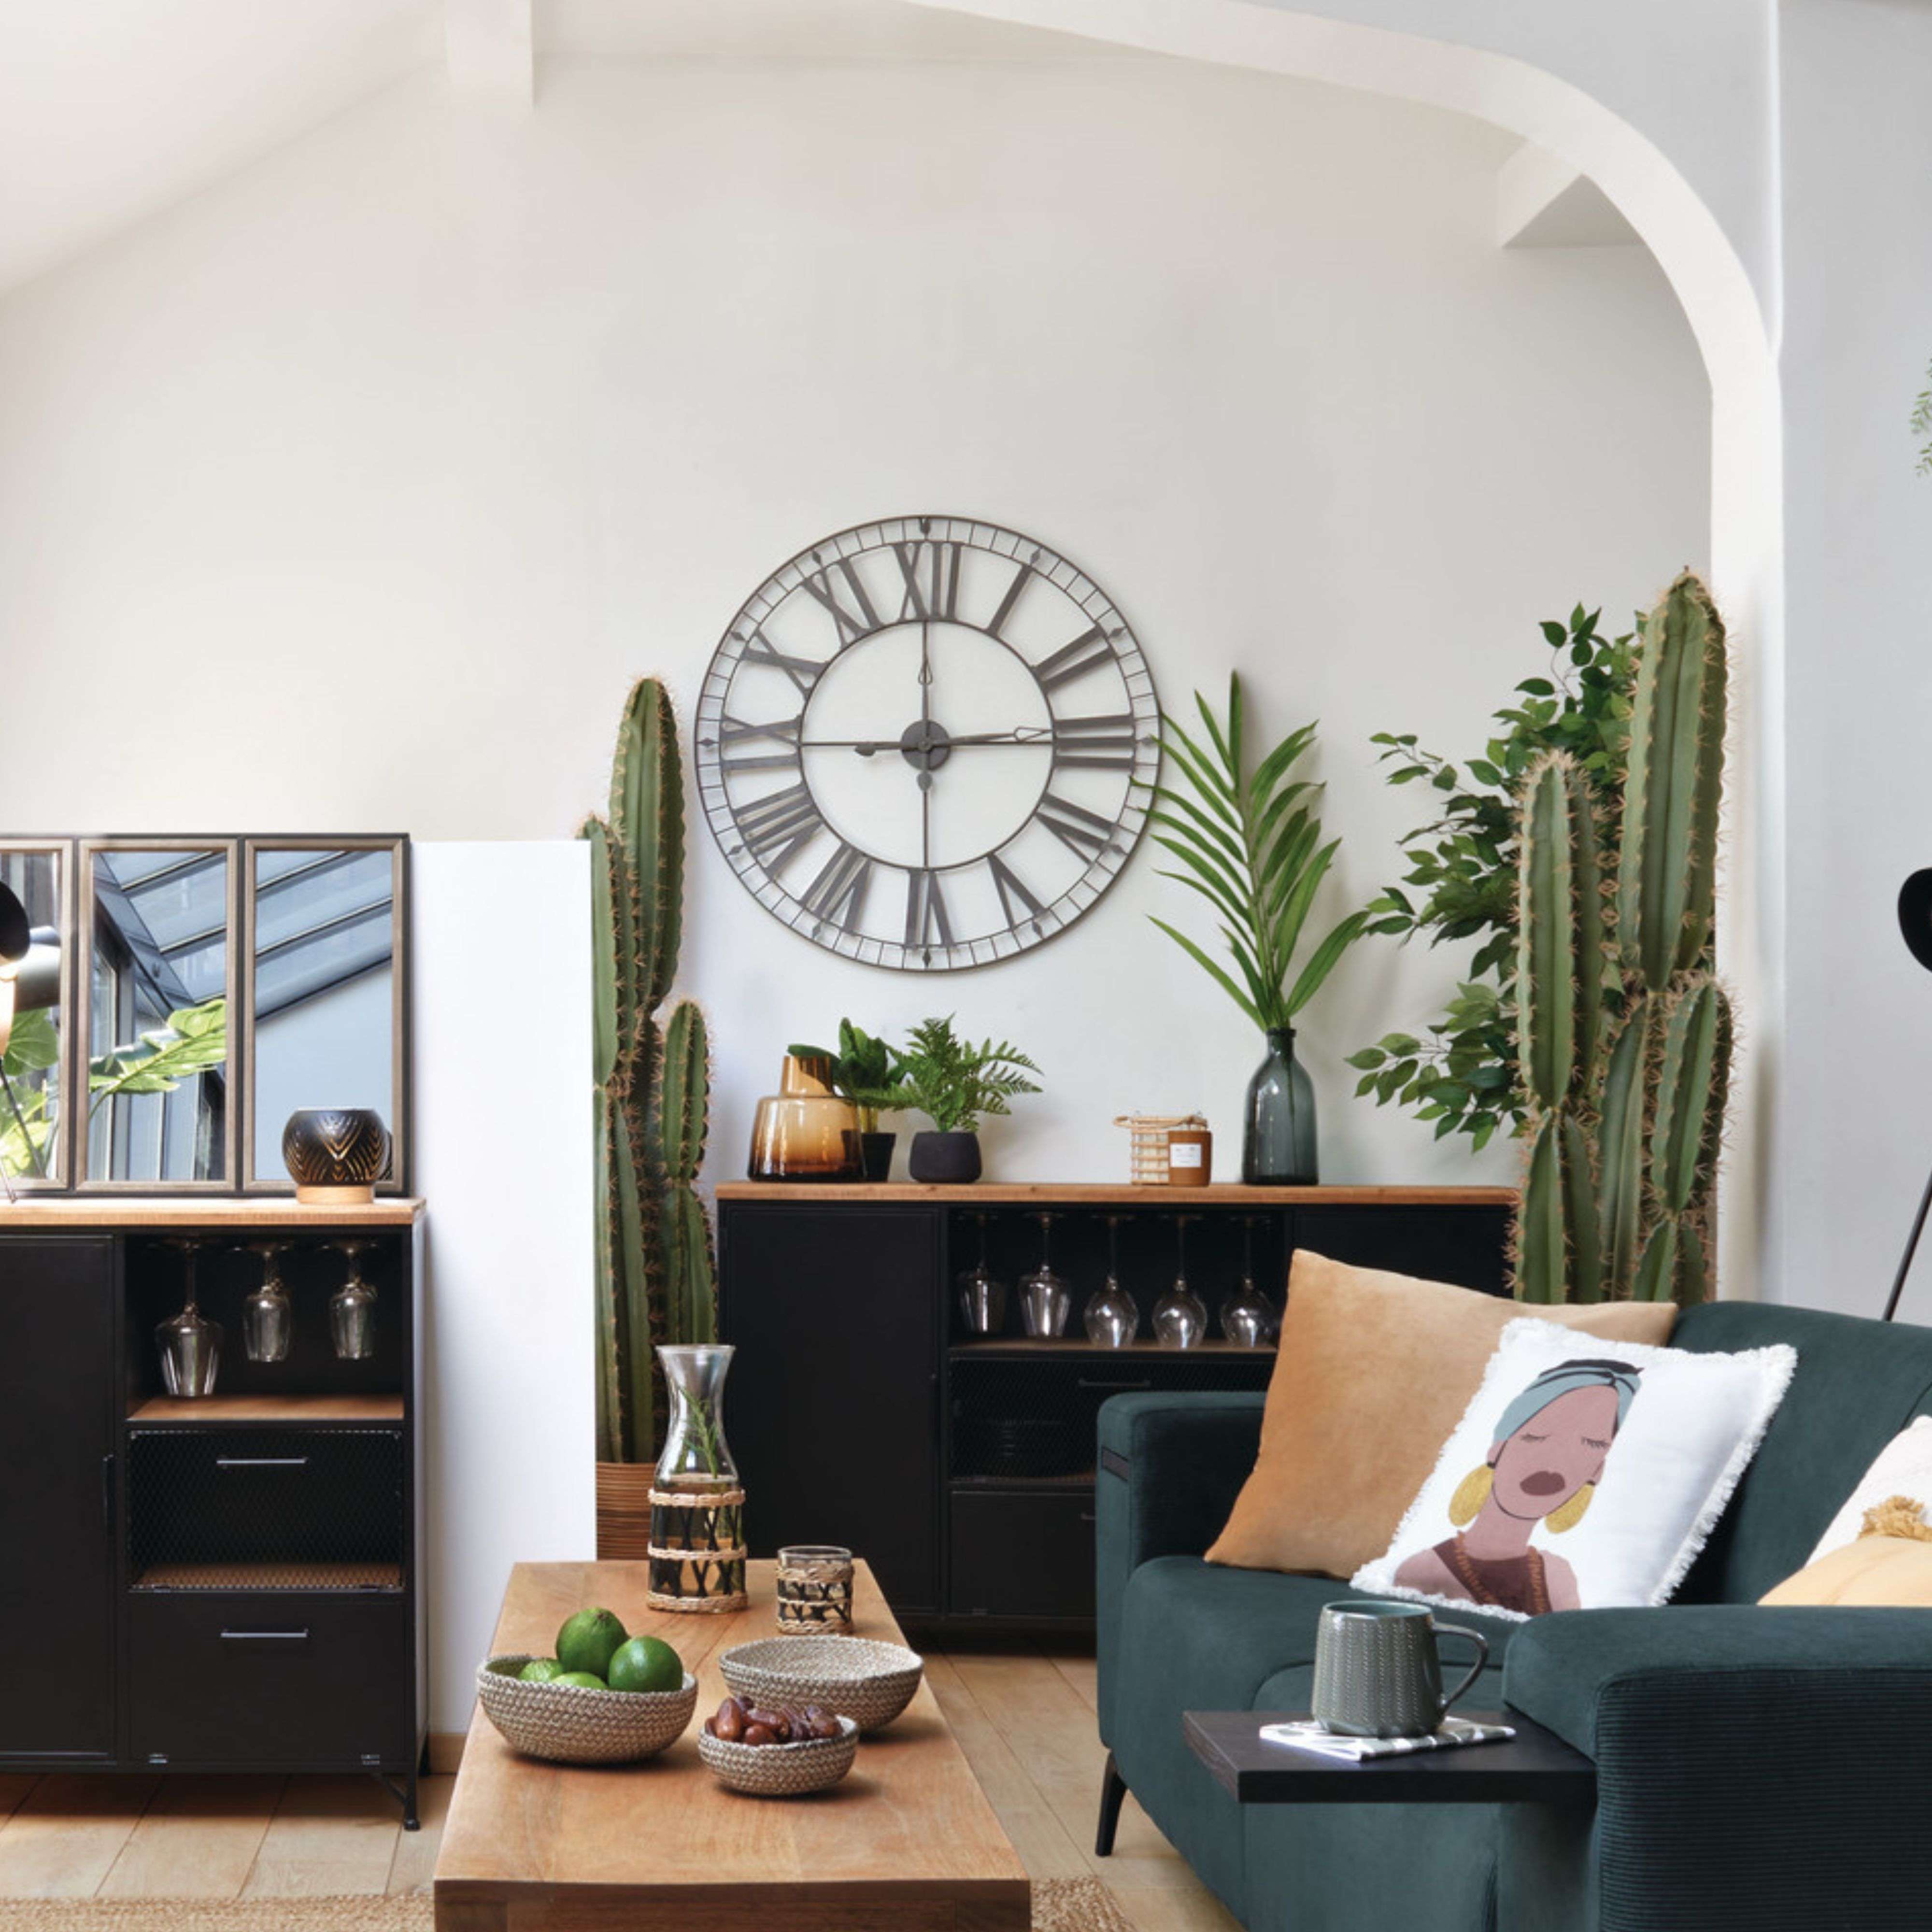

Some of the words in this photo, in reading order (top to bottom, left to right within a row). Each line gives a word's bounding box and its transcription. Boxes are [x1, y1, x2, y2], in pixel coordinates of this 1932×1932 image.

[799, 557, 883, 649] XI
[893, 541, 961, 621] XII
[986, 564, 1033, 638] I
[739, 629, 830, 702] X
[1030, 624, 1119, 694] II
[720, 713, 801, 770] IX
[1053, 713, 1135, 769] III
[733, 782, 824, 880] VIII
[1033, 791, 1120, 867] IV
[798, 841, 872, 935] VII
[904, 868, 957, 948] VI
[986, 852, 1049, 931] V
